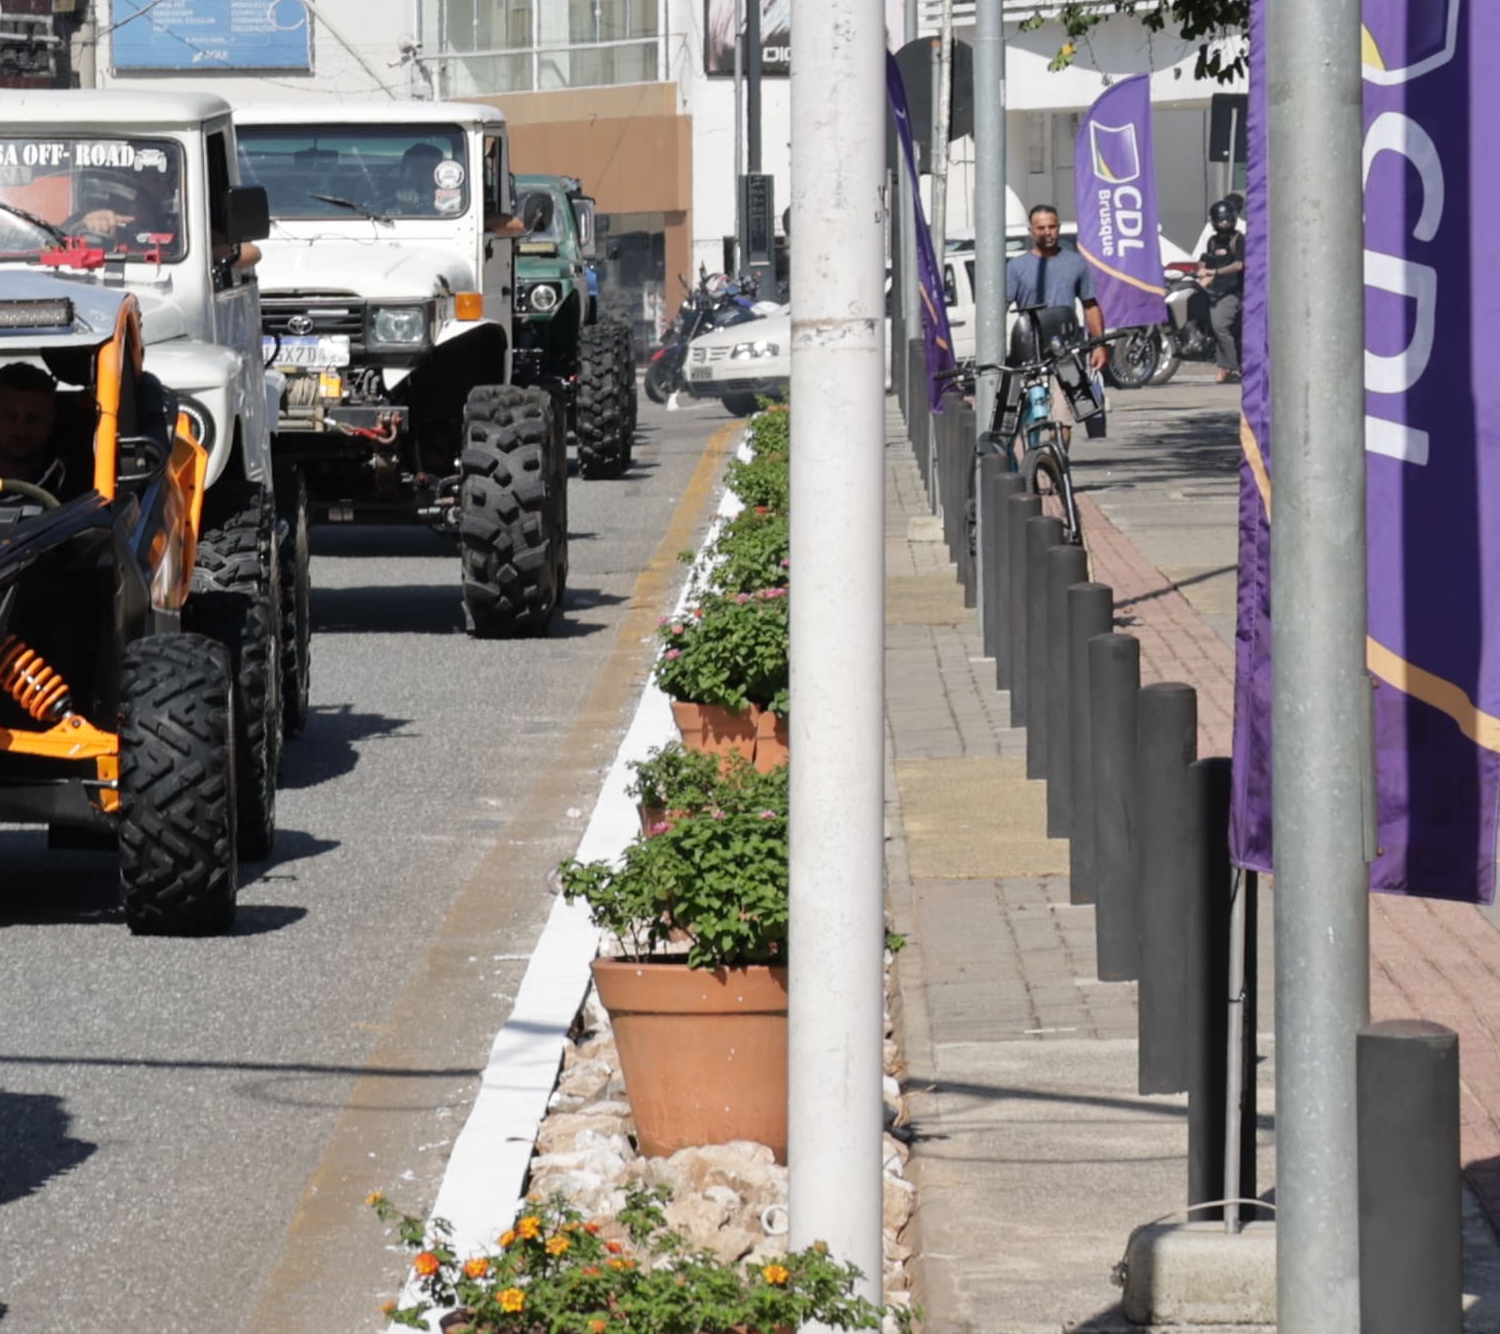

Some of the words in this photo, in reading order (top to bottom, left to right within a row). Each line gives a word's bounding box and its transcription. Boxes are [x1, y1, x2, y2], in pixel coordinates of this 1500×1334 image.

[75, 144, 135, 168] ROAD
[1098, 188, 1114, 257] Brusque
[1113, 185, 1145, 257] CDL
